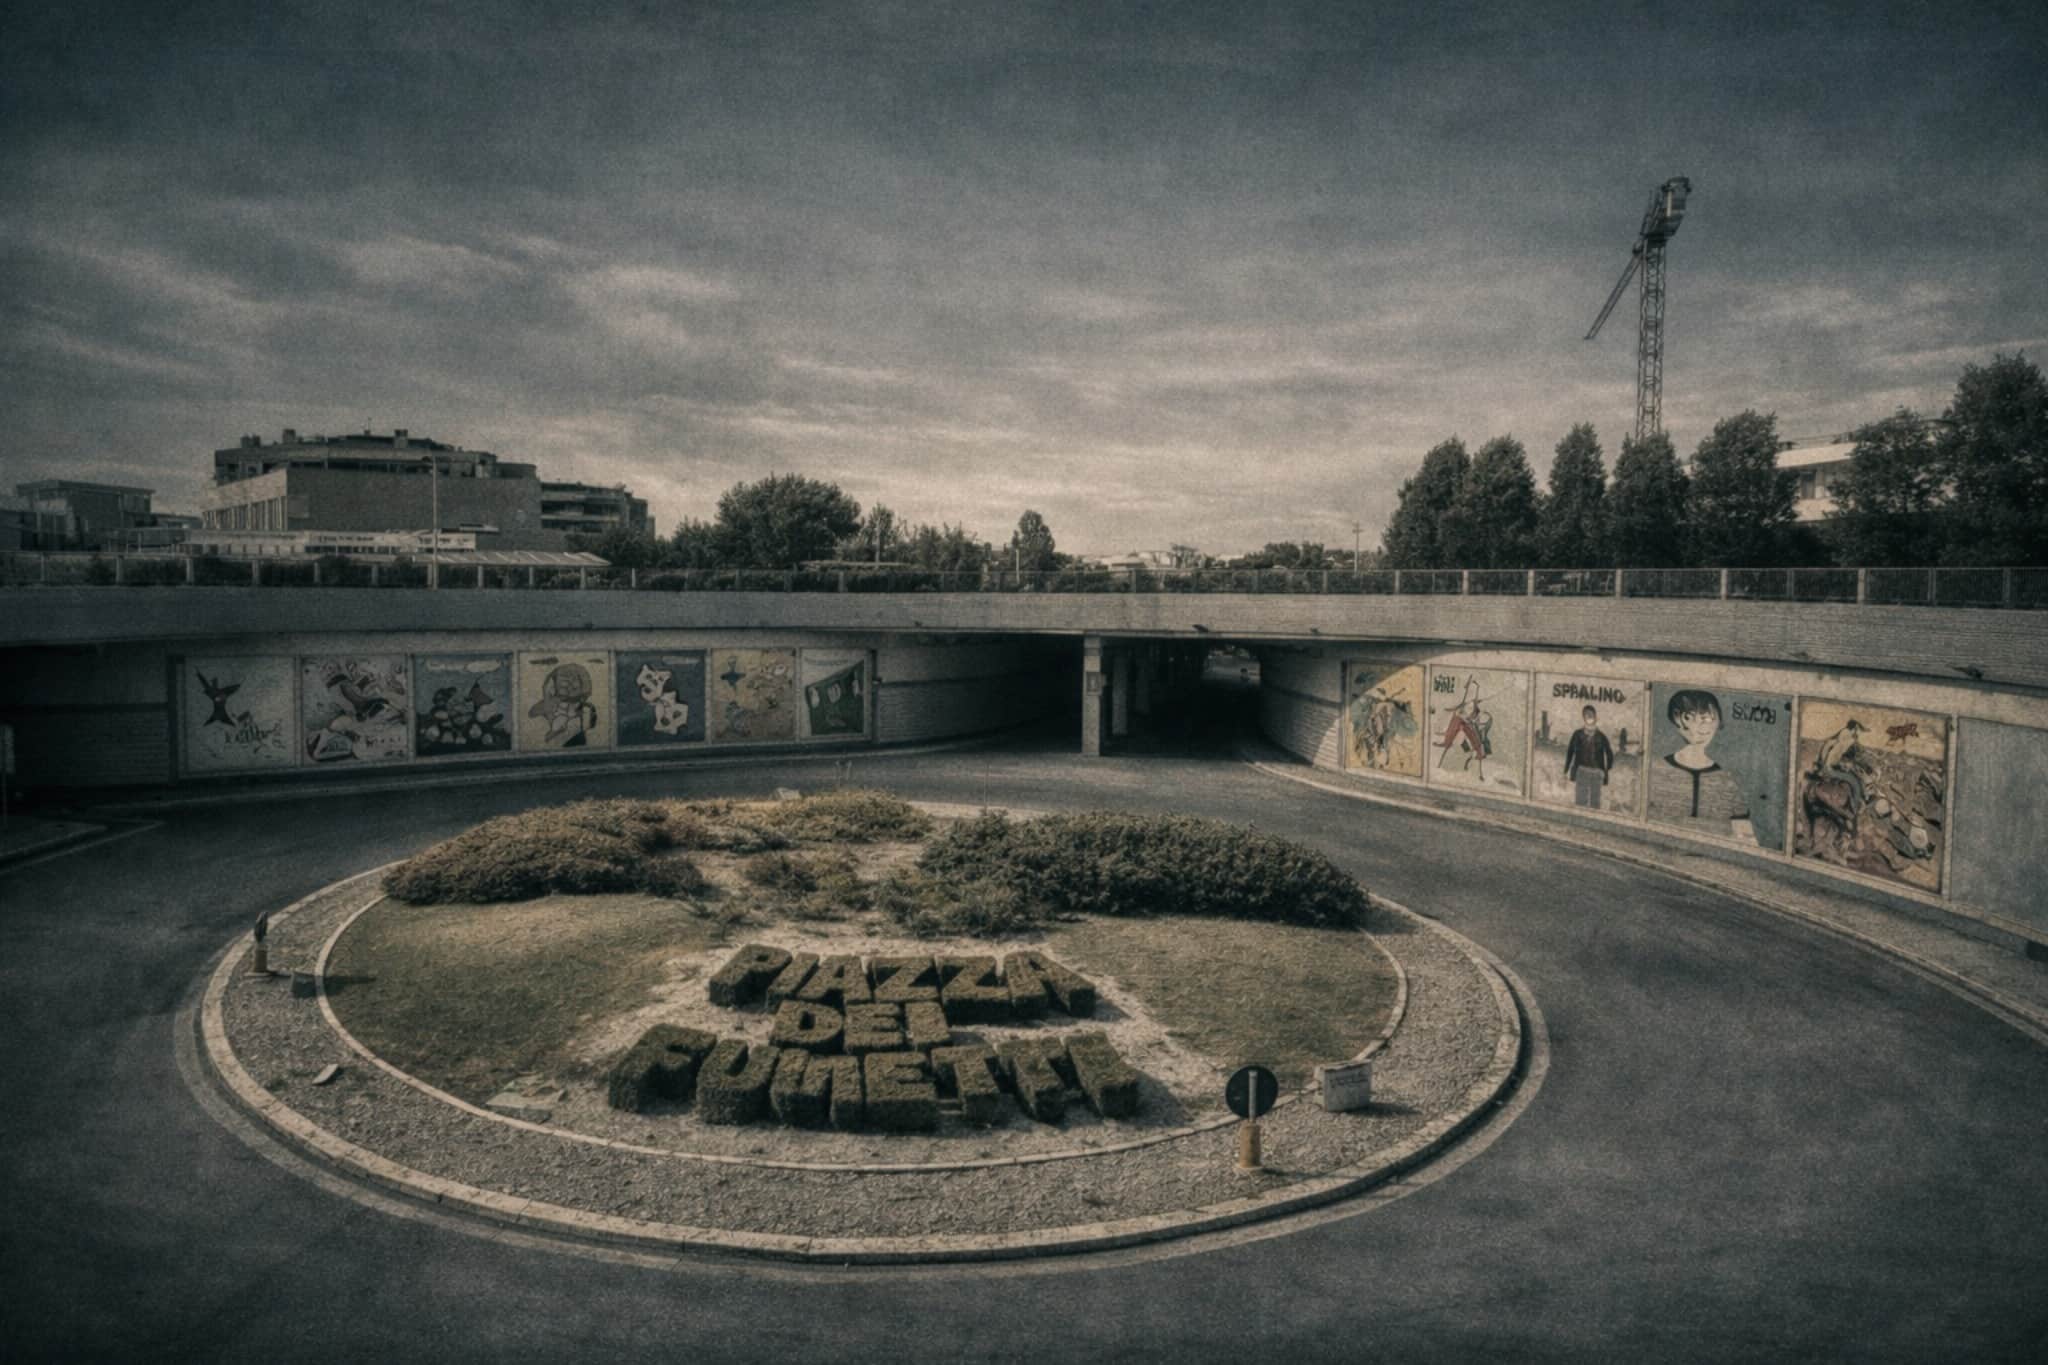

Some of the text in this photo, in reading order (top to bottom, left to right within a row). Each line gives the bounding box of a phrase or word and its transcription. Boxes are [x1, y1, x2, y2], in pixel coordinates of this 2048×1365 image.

[708, 943, 1098, 1018] PIAZZA
[769, 1001, 952, 1052] DEI
[608, 1022, 1141, 1132] FUMETTI
